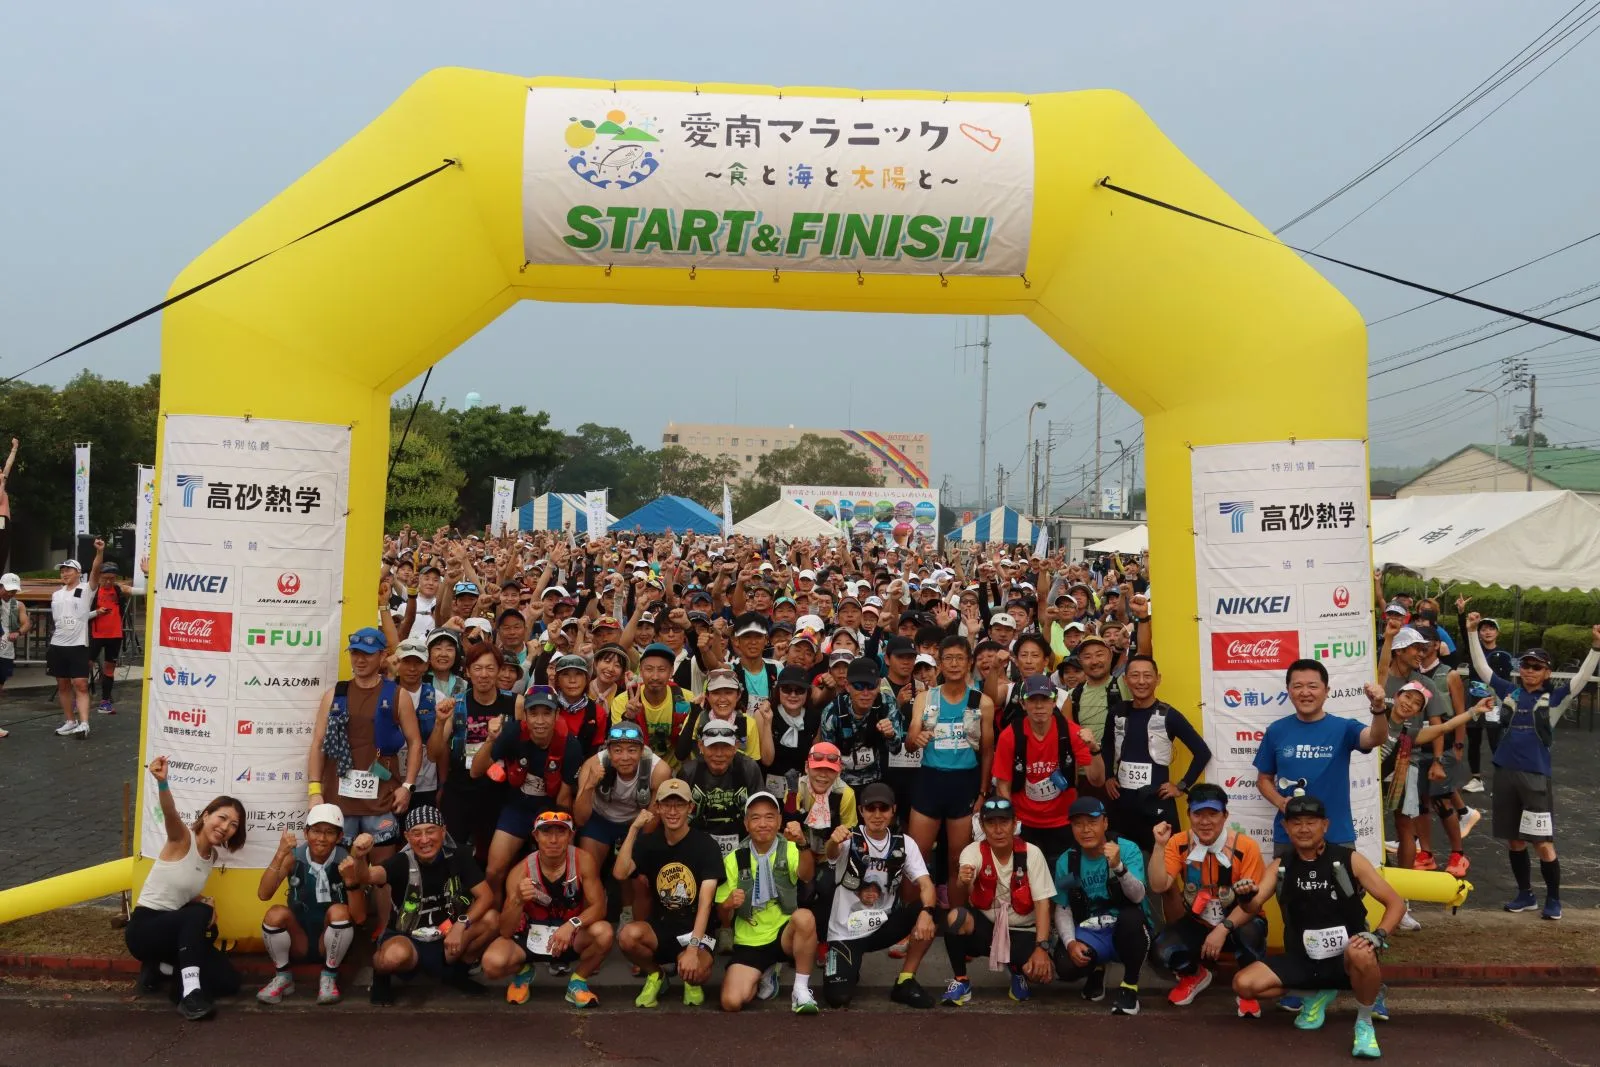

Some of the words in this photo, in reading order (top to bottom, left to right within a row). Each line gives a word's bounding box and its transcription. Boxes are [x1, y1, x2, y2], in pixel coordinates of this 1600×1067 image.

[680, 111, 950, 152] 愛南マラニック
[562, 205, 993, 261] START&FINISH
[222, 439, 270, 451] 特別協賛
[1271, 461, 1316, 473] 特別協賛
[207, 482, 321, 514] 高砂熱学
[1260, 502, 1356, 532] 高砂熱学
[165, 572, 229, 594] NIKKEI
[1215, 595, 1291, 615] NIKKEI
[170, 616, 215, 637] Coca-Cola
[270, 629, 322, 647] FUJI
[1227, 639, 1281, 658] Coca-Cola
[1332, 640, 1366, 659] FUJI
[177, 671, 217, 688] 南レク
[264, 677, 321, 687] JAえひめ南
[1243, 691, 1289, 706] 南レク
[1331, 686, 1366, 698] JAえひめ
[168, 708, 206, 727] meiji
[163, 726, 211, 738] 四国明治株式会社
[860, 753, 871, 763] 45
[167, 760, 194, 771] POWER
[194, 763, 218, 774] Group
[1128, 770, 1148, 781] 534
[354, 779, 375, 789] 392
[1536, 820, 1547, 828] 81
[868, 916, 882, 928] 68
[1322, 935, 1344, 949] 387
